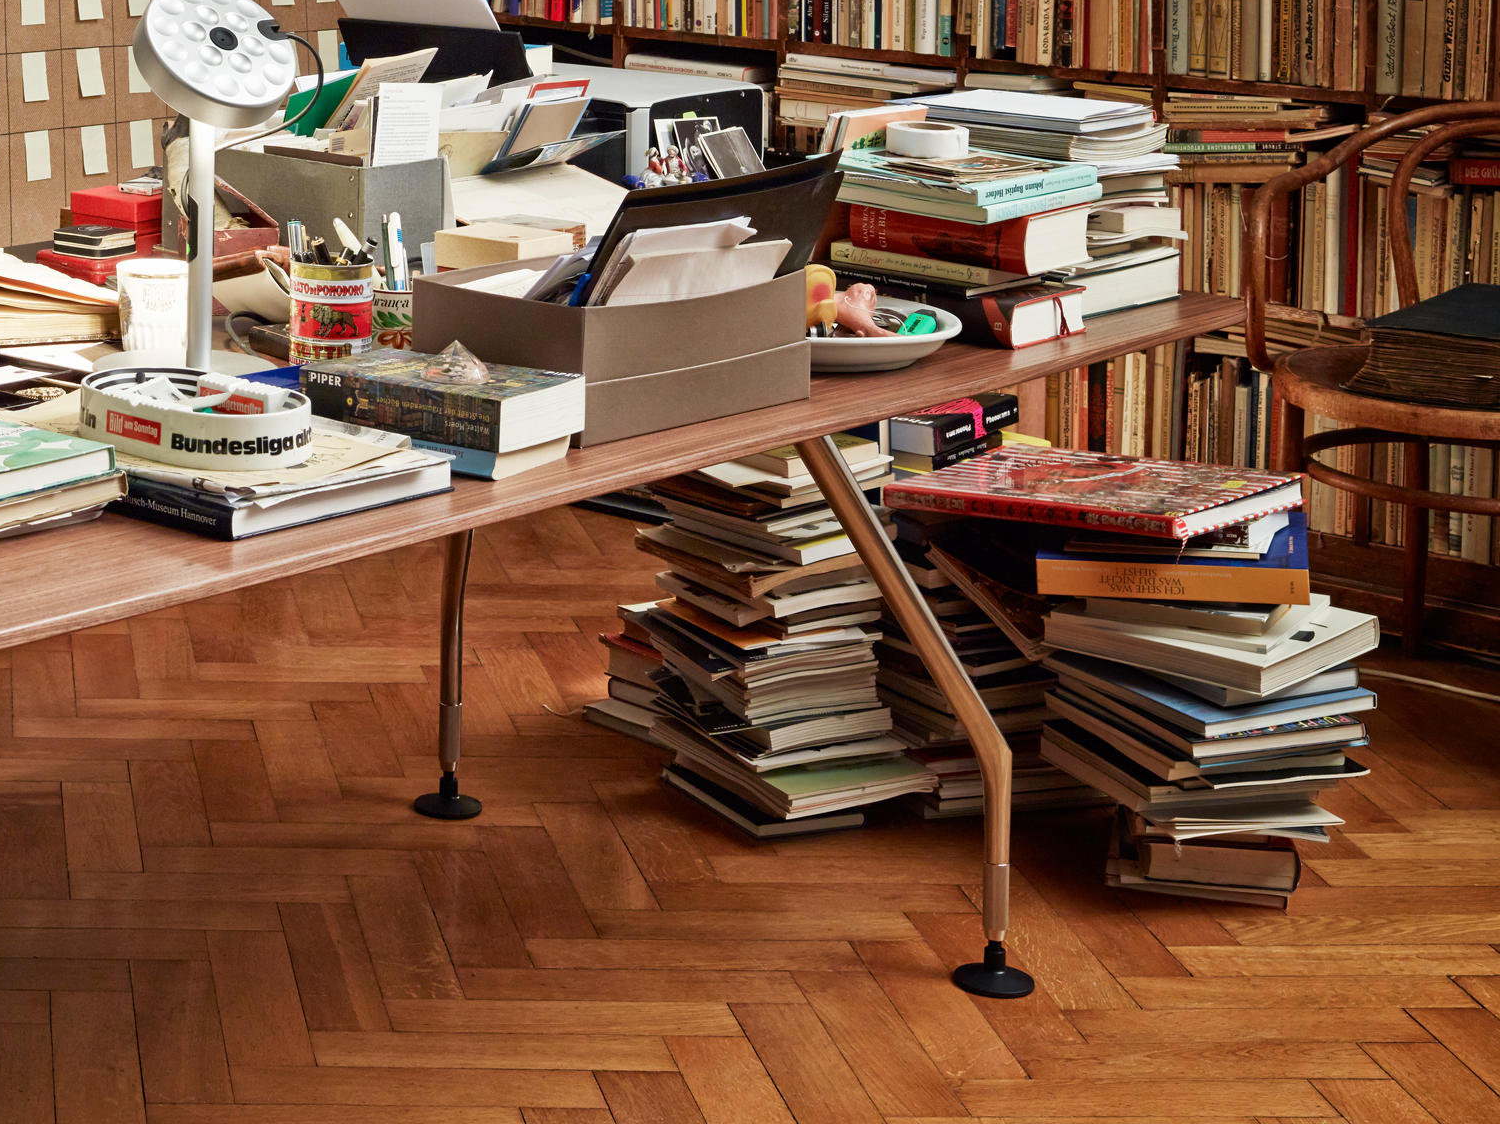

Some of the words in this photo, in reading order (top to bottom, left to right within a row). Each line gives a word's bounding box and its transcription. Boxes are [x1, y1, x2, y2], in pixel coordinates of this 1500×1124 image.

[822, 1, 830, 23] Silent
[1305, 30, 1313, 47] Buch
[1005, 185, 1024, 195] Baptist
[1024, 179, 1044, 191] Johann
[316, 284, 364, 296] POMODORO
[310, 372, 341, 387] PIPER
[377, 397, 399, 408] Bücher
[402, 400, 442, 415] Träumenden
[444, 408, 457, 417] der
[459, 410, 476, 420] Stadt
[478, 413, 490, 423] Die
[986, 410, 1010, 424] Phonorama
[108, 412, 124, 433] Bild
[124, 420, 133, 429] am
[133, 421, 158, 438] Sonntag
[445, 420, 465, 430] Moers
[467, 423, 490, 435] Walter
[946, 424, 971, 438] Phonorama
[171, 433, 294, 455] Bundesliga
[181, 507, 216, 526] Hannover
[1123, 567, 1157, 577] SIEHST
[1099, 575, 1137, 585] NICHT
[1137, 576, 1156, 585] DU
[1157, 577, 1181, 586] WAS
[1135, 584, 1160, 594] SEHE
[1161, 585, 1185, 595] ICH
